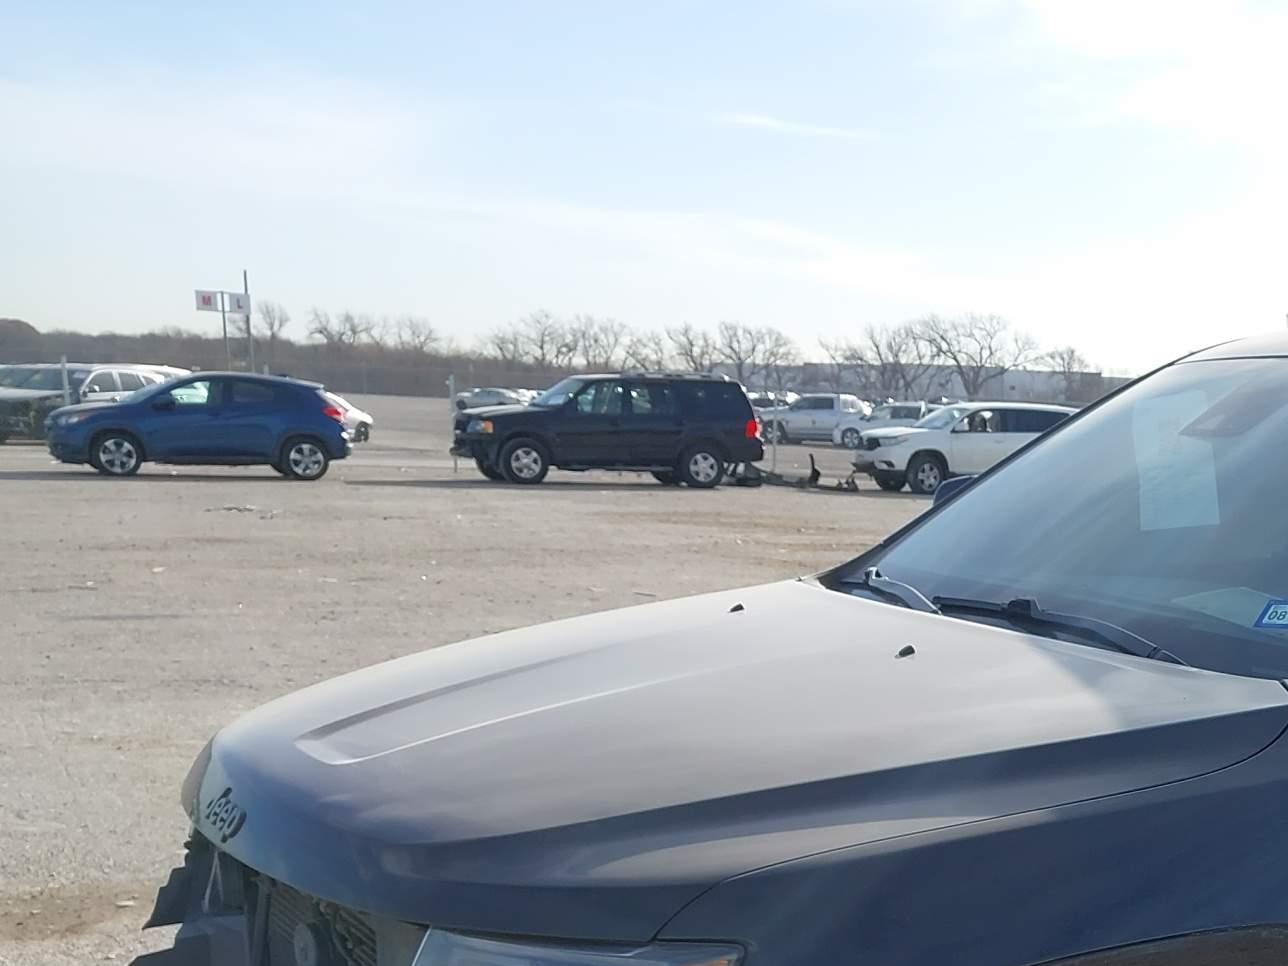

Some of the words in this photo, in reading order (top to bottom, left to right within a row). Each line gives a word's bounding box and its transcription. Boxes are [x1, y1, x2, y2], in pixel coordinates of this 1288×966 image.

[202, 295, 212, 306] M
[236, 298, 244, 310] L
[1267, 610, 1288, 621] 08
[205, 787, 247, 843] Jeep
